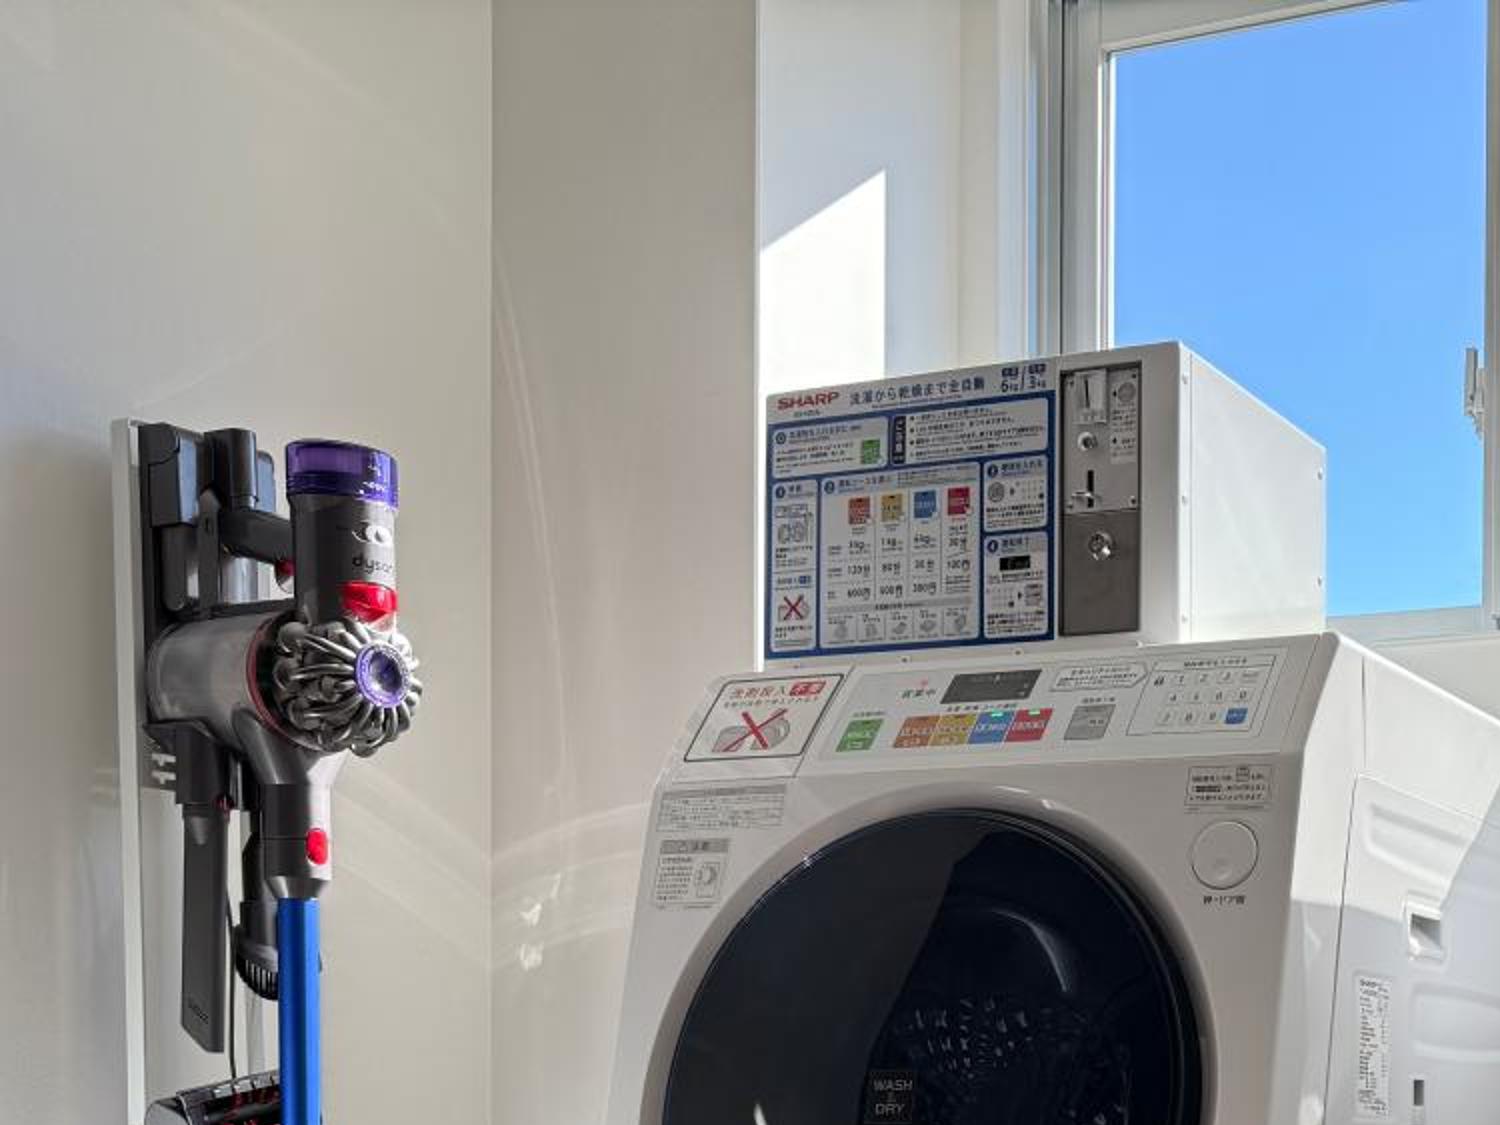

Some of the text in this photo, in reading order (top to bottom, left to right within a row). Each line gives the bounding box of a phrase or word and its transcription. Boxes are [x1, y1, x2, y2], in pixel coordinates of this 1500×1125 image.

[777, 391, 840, 411] SHARP
[873, 1079, 913, 1091] WASH
[875, 1103, 905, 1116] DRY
